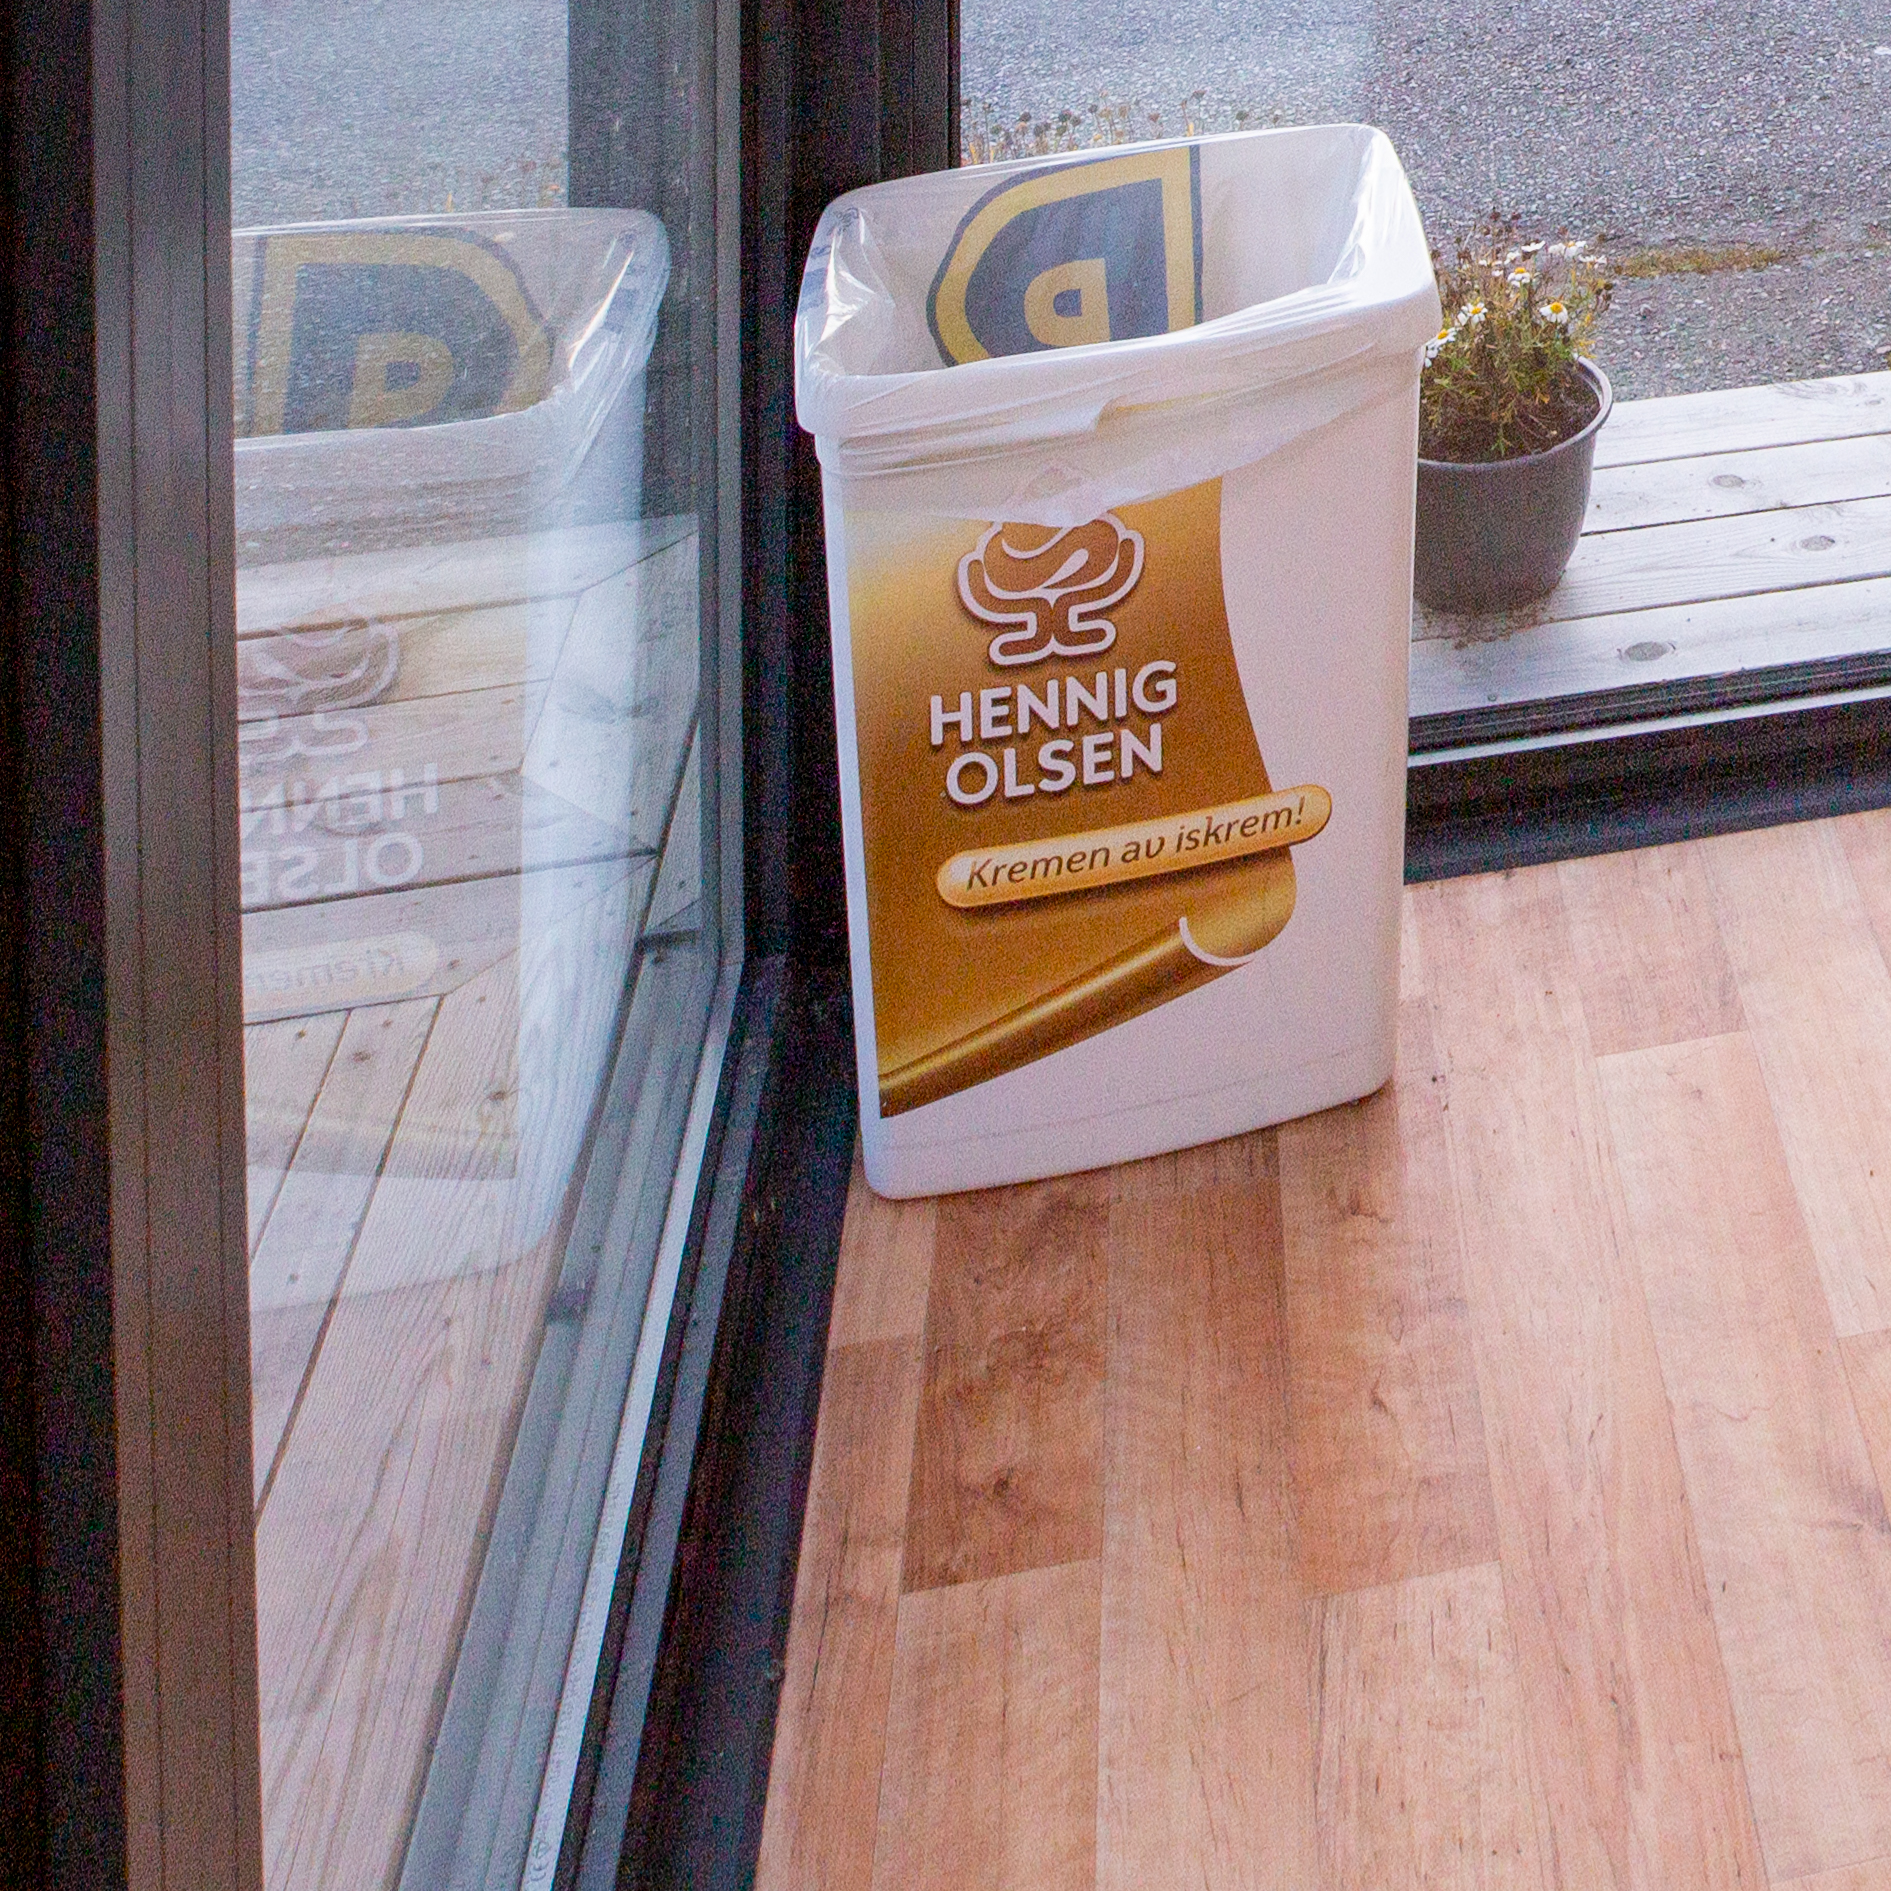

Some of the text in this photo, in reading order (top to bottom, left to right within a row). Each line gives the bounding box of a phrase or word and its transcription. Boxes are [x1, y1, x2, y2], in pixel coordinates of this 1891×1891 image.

[930, 660, 1178, 746] HENNIG
[945, 723, 1164, 806] OLSEN
[965, 795, 1307, 894] Kremen av iskrem!
